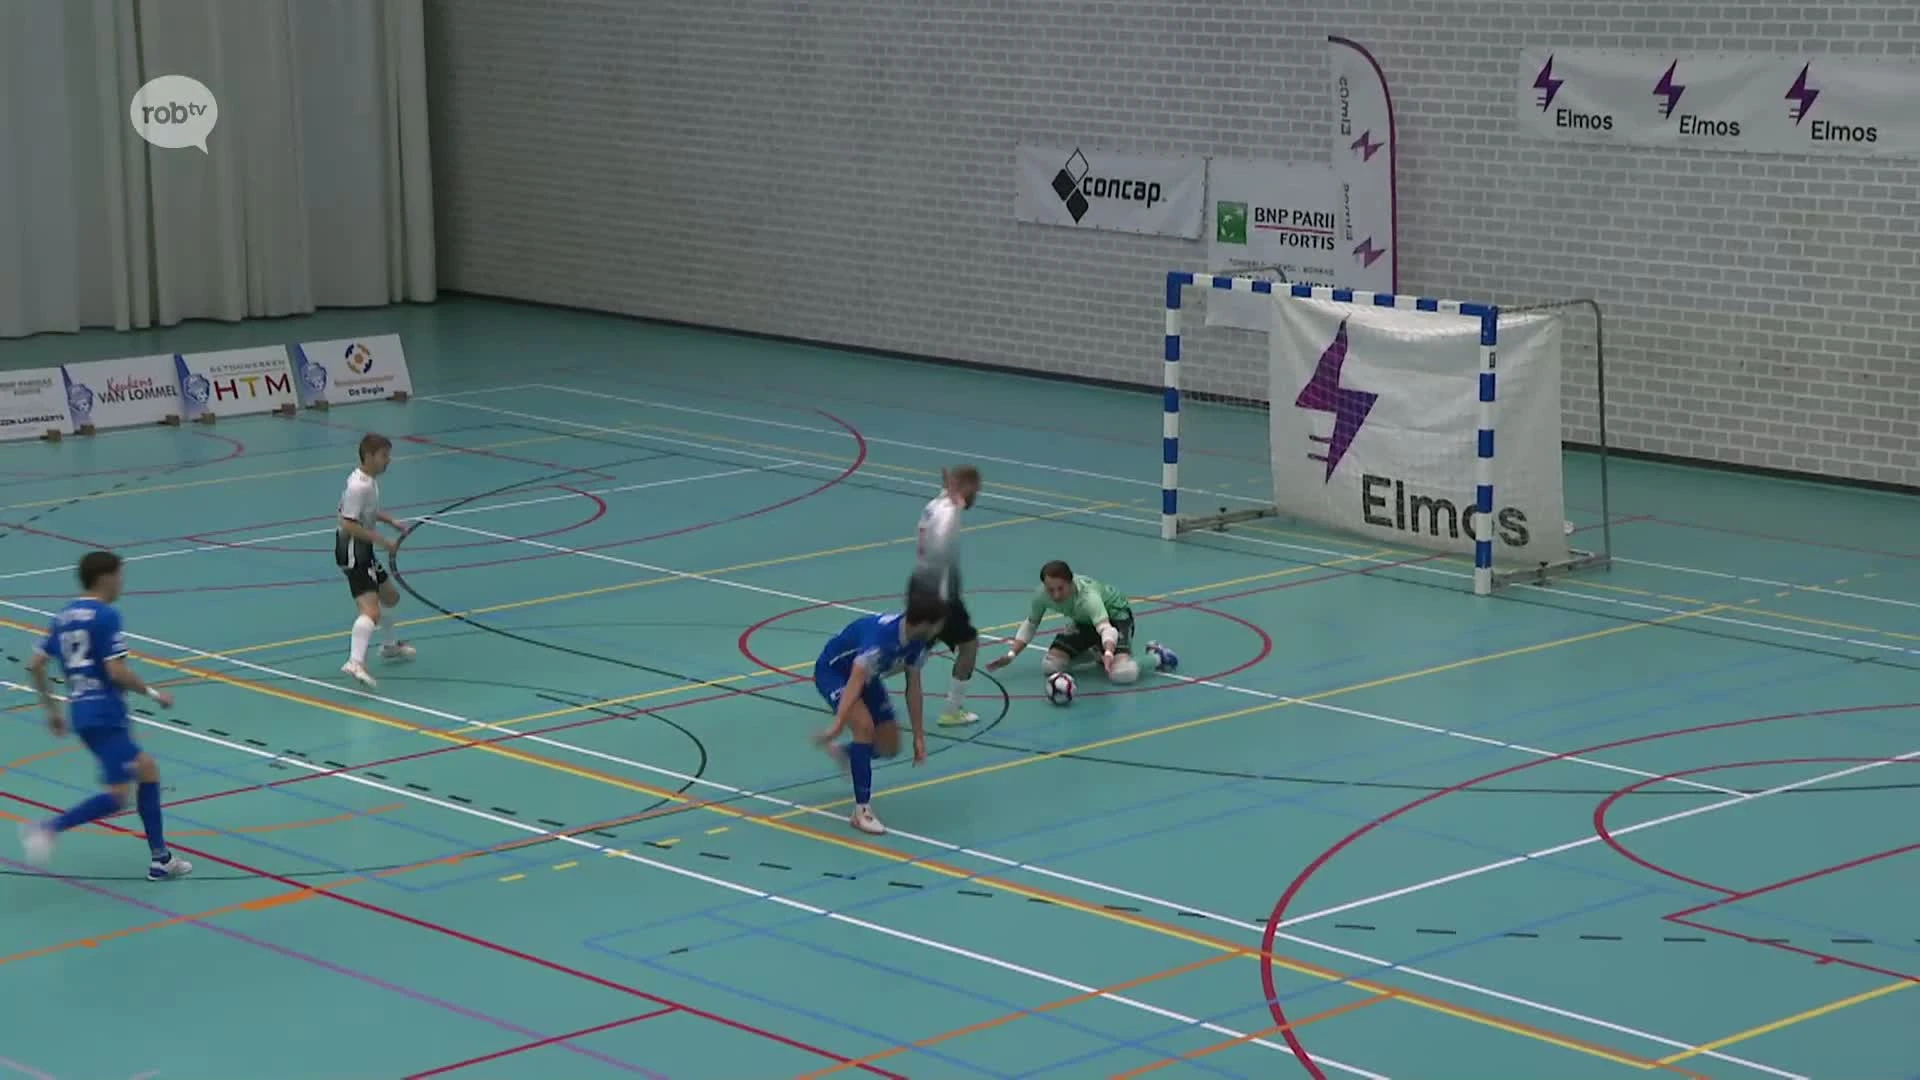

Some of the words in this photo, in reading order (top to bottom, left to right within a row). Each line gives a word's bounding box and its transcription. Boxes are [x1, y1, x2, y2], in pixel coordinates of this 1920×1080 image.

[1556, 108, 1613, 130] Elmos
[1679, 115, 1741, 137] Elmos
[1811, 120, 1878, 143] Elmos
[1082, 176, 1162, 209] concap
[1255, 207, 1289, 224] BNP
[1293, 211, 1335, 229] PARI
[1280, 232, 1335, 251] FORTIS
[97, 391, 125, 404] VAN
[128, 385, 178, 401] LOMMEL
[213, 373, 291, 401] HTM
